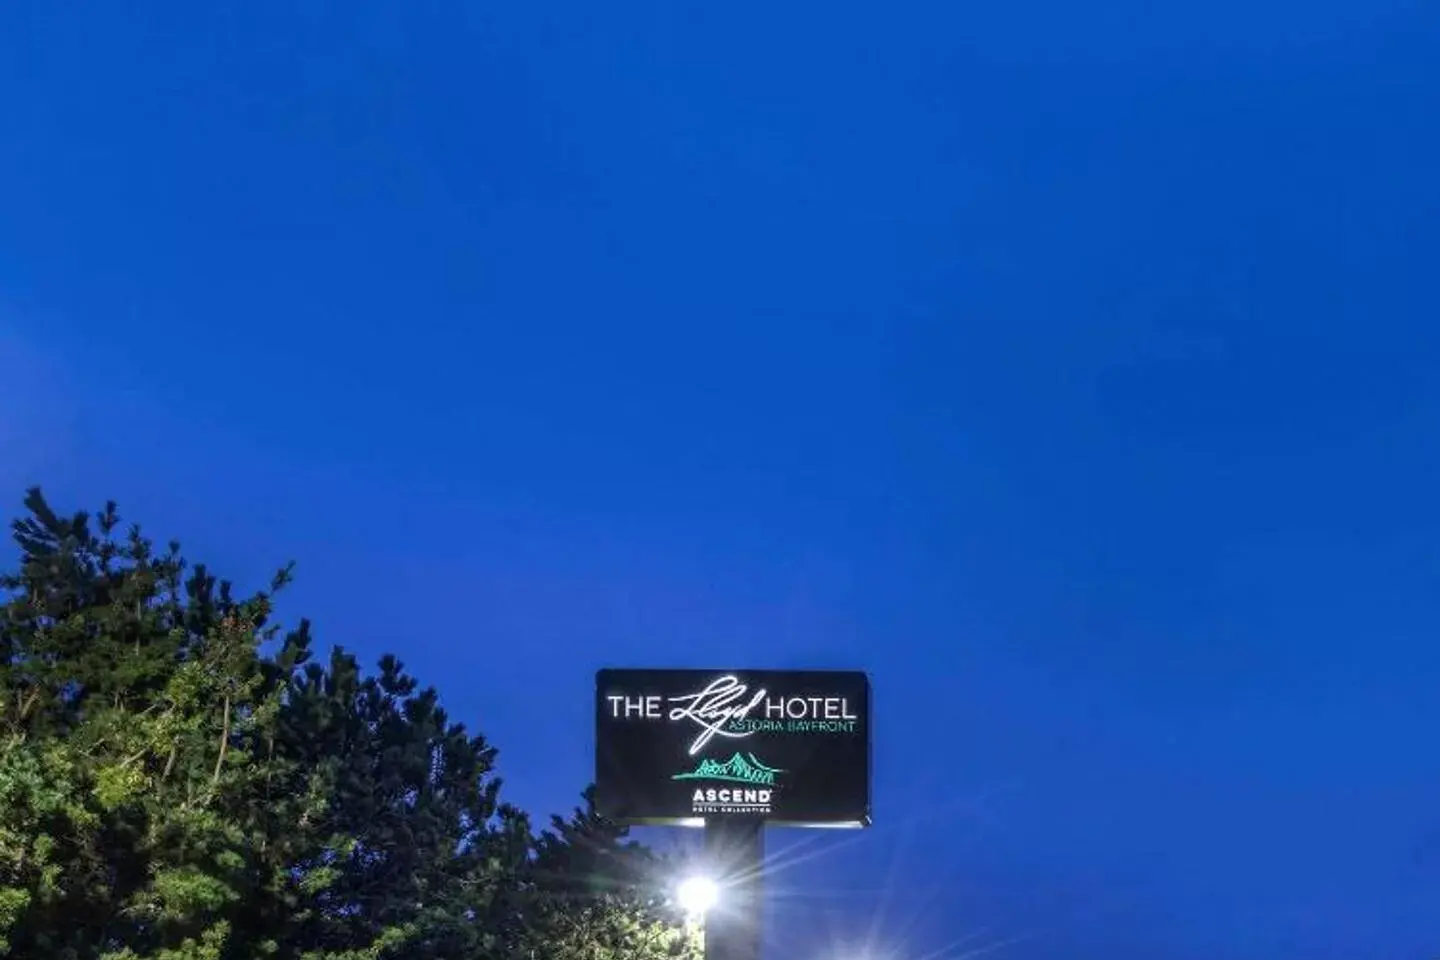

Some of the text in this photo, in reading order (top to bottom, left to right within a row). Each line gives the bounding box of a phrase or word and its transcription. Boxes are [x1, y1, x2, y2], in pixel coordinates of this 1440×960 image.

[608, 675, 857, 755] THE Lloyd HOTEL
[728, 720, 856, 732] ASTORIA BAYFRONT
[692, 789, 771, 803] ASCEND
